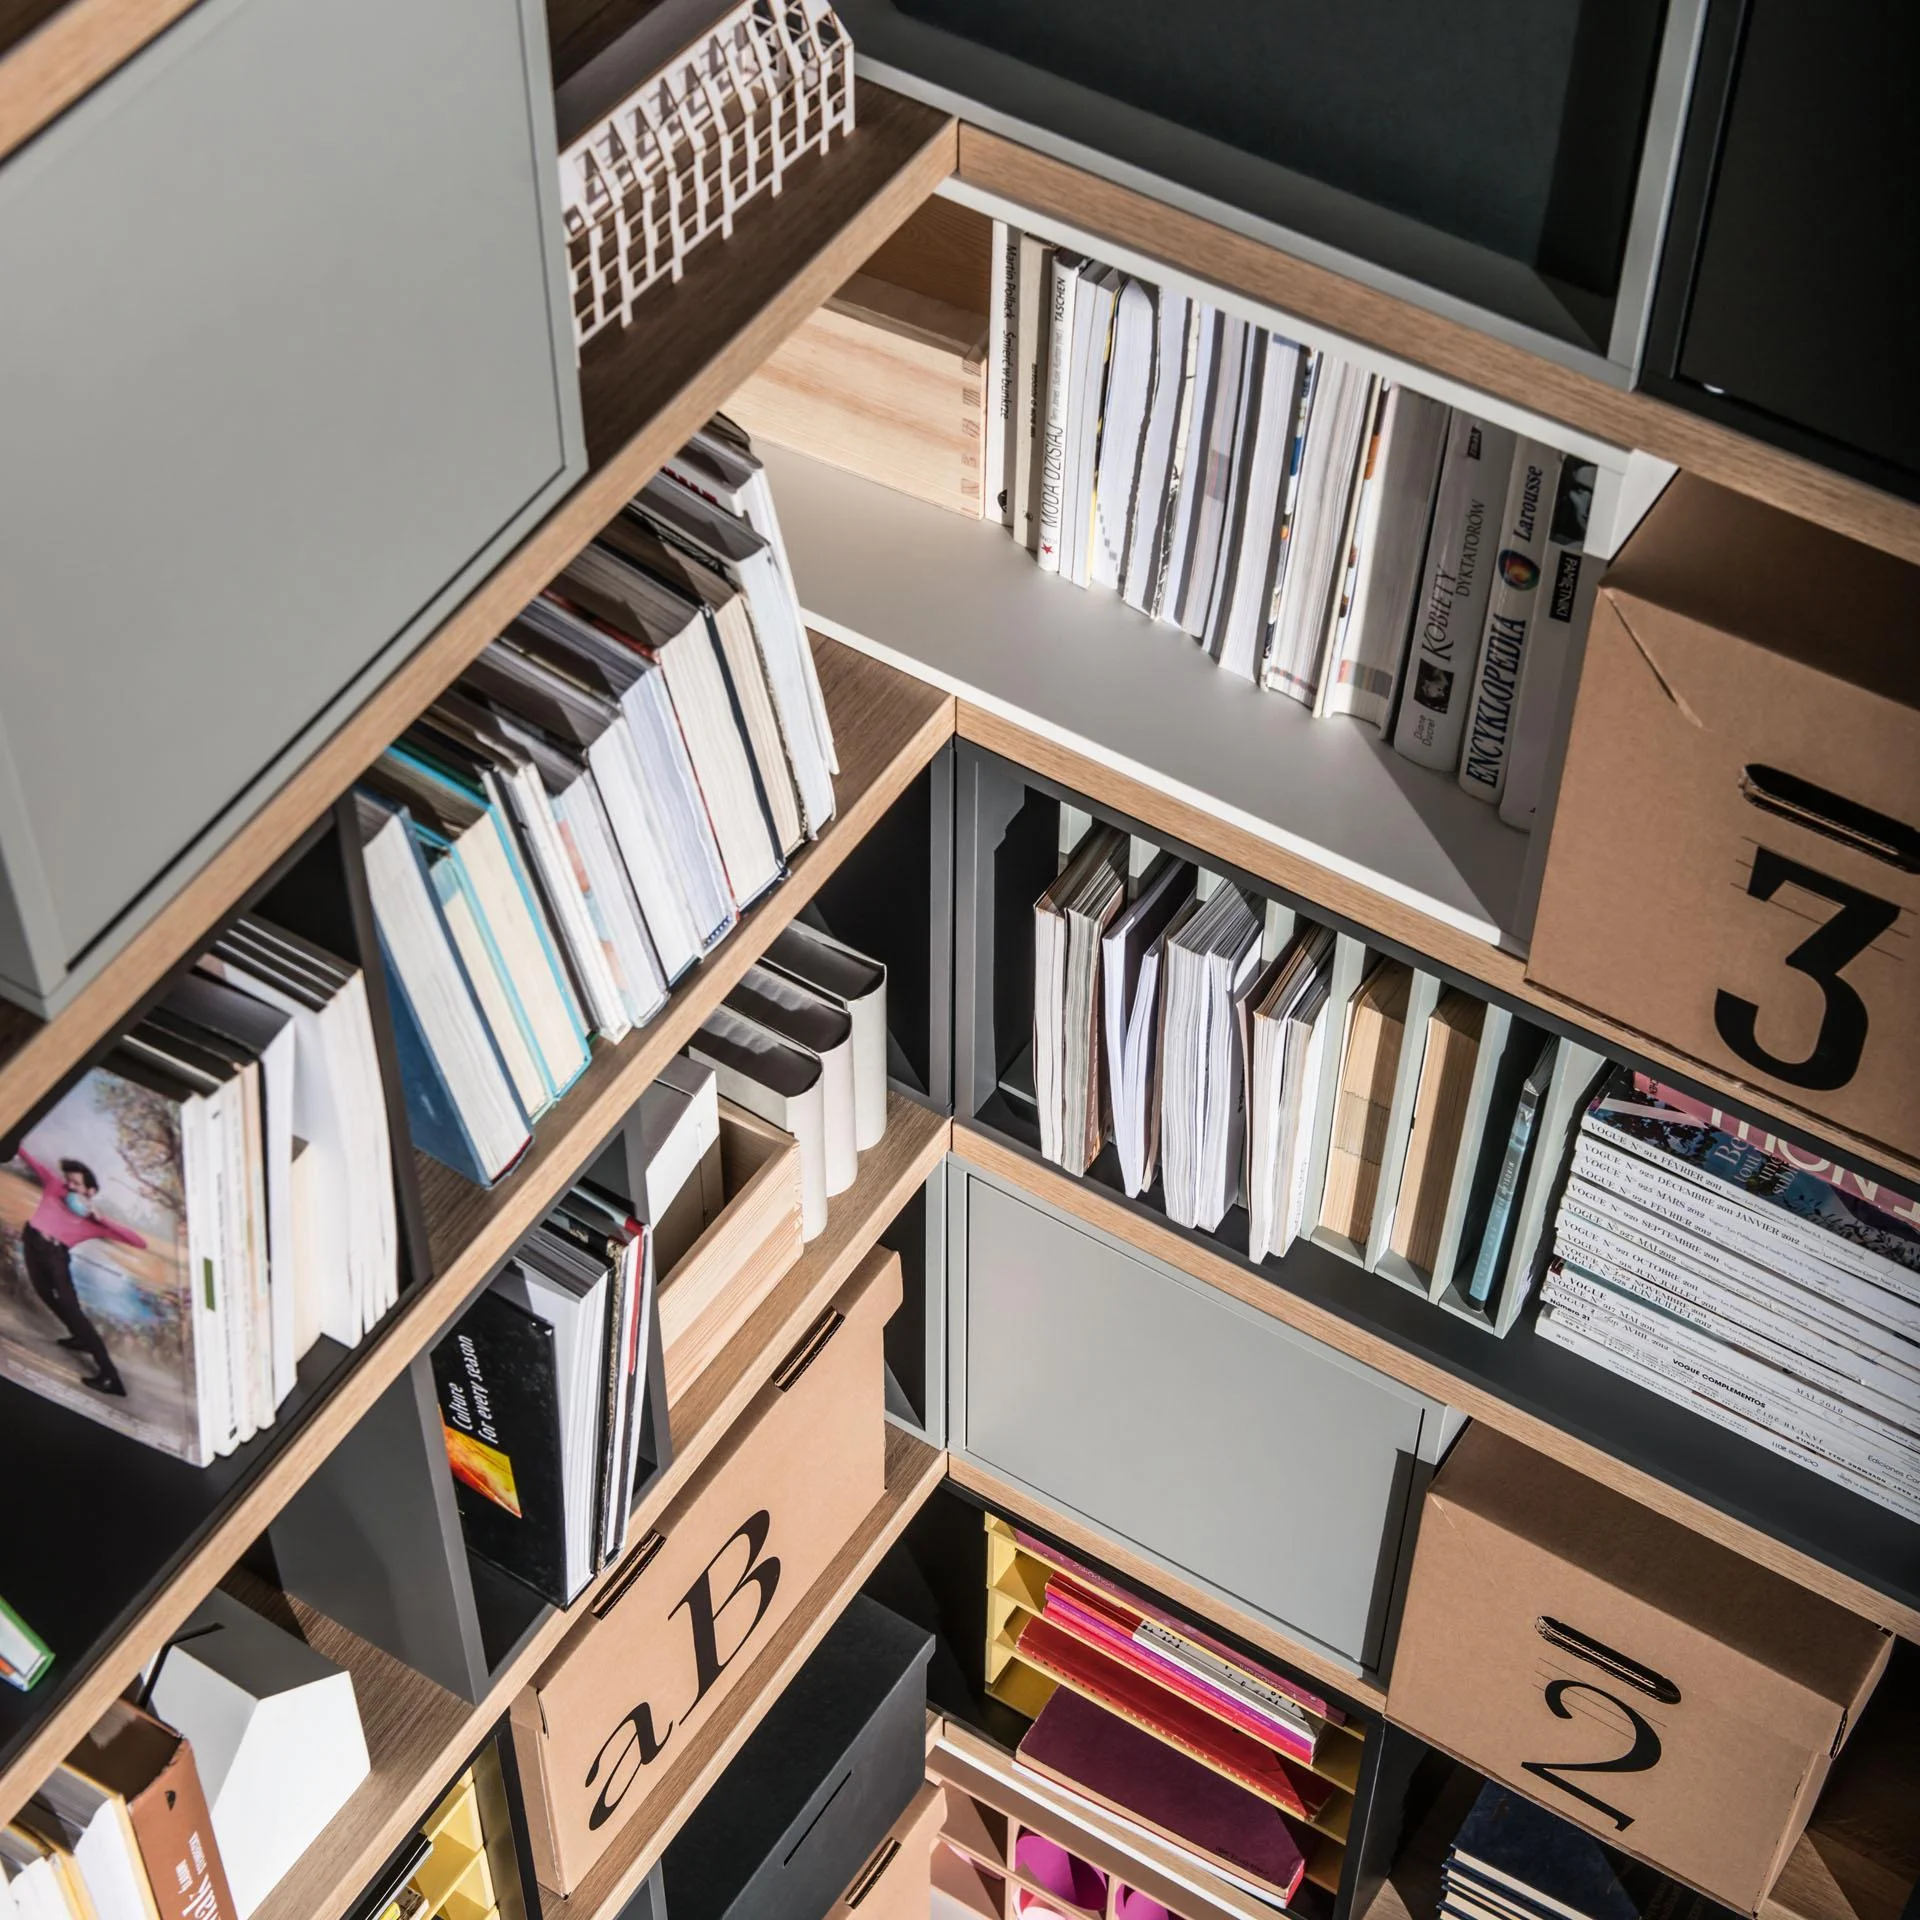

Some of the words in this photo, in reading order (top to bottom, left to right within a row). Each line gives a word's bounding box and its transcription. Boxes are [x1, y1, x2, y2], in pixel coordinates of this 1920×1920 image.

[1004, 244, 1017, 280] Martin
[1003, 281, 1016, 320] Pollack
[1055, 277, 1067, 323] TASCHEN
[1002, 364, 1016, 421] bunkrze
[1041, 479, 1059, 528] MODA
[1512, 465, 1545, 544] Larousse
[1453, 497, 1486, 598] DYKTATORÓW
[1418, 563, 1459, 661] KOBIETY
[1465, 616, 1527, 789] ENCYKLOPEDIA
[1714, 845, 1906, 1092] 3
[1582, 1154, 1622, 1178] VOGUE
[1655, 1190, 1686, 1209] MARS
[1686, 1206, 1706, 1218] 2012
[1589, 1121, 1627, 1144] VOGUE
[1642, 1149, 1657, 1160] 914
[1659, 1154, 1705, 1182] FÉVRIER
[1704, 1178, 1722, 1190] 2011
[1569, 1183, 1608, 1207] VOGUE
[1622, 1211, 1639, 1222] 920
[1640, 1219, 1702, 1253] SEPTEMBRE
[1702, 1250, 1720, 1262] 2011
[1578, 1165, 1617, 1189] VOGUE
[1649, 1201, 1693, 1227] FÉVRIER
[1692, 1224, 1712, 1237] 2012
[1582, 1142, 1623, 1165] VOGUE
[1656, 1175, 1715, 1206] DÉCEMBRE
[1714, 1203, 1734, 1215] 2011
[1734, 1210, 1780, 1236] JANVIER
[1779, 1232, 1800, 1245] 2012
[1561, 1218, 1601, 1242] VOGUE
[1630, 1253, 1680, 1281] OCTOBRE
[1681, 1279, 1699, 1291] 2011
[1565, 1201, 1605, 1226] VOGUE
[1618, 1229, 1635, 1240] 927
[1636, 1237, 1658, 1252] MAI
[1657, 1249, 1677, 1261] 2012
[1549, 1275, 1588, 1299] VOGUE
[1601, 1302, 1616, 1313] 917
[1618, 1310, 1639, 1324] MAI
[1638, 1321, 1656, 1332] 2011
[1558, 1248, 1596, 1271] VOGUE
[1628, 1284, 1652, 1299] JUIN
[1652, 1295, 1693, 1319] JUILLET
[1693, 1316, 1712, 1329] 2012
[1562, 1243, 1600, 1266] VOGUE
[1632, 1279, 1688, 1309] NOVEMBRE
[1690, 1307, 1708, 1319] 2011
[1564, 1232, 1603, 1256] VOGUE
[1634, 1267, 1658, 1282] JUIN
[1659, 1279, 1699, 1302] JUILLET
[1700, 1300, 1718, 1311] 2011
[1567, 1276, 1608, 1301] VOGUE
[1551, 1289, 1589, 1310] VOGUE
[1621, 1324, 1648, 1339] AVRIL
[1649, 1338, 1669, 1351] 2012
[457, 1333, 483, 1382] season
[1548, 1297, 1581, 1316] Número
[1581, 1313, 1591, 1321] 21
[1671, 1358, 1701, 1376] VOGUE
[1700, 1372, 1766, 1408] COMPLEMENTOS
[1866, 1454, 1905, 1477] Ediciones
[448, 1381, 473, 1431] Culture
[469, 1379, 492, 1420] every
[478, 1419, 498, 1444] for
[1770, 1440, 1787, 1452] 2011
[1787, 1448, 1819, 1467] Octubre
[585, 1508, 783, 1832] aB
[1521, 1679, 1662, 1833] 2
